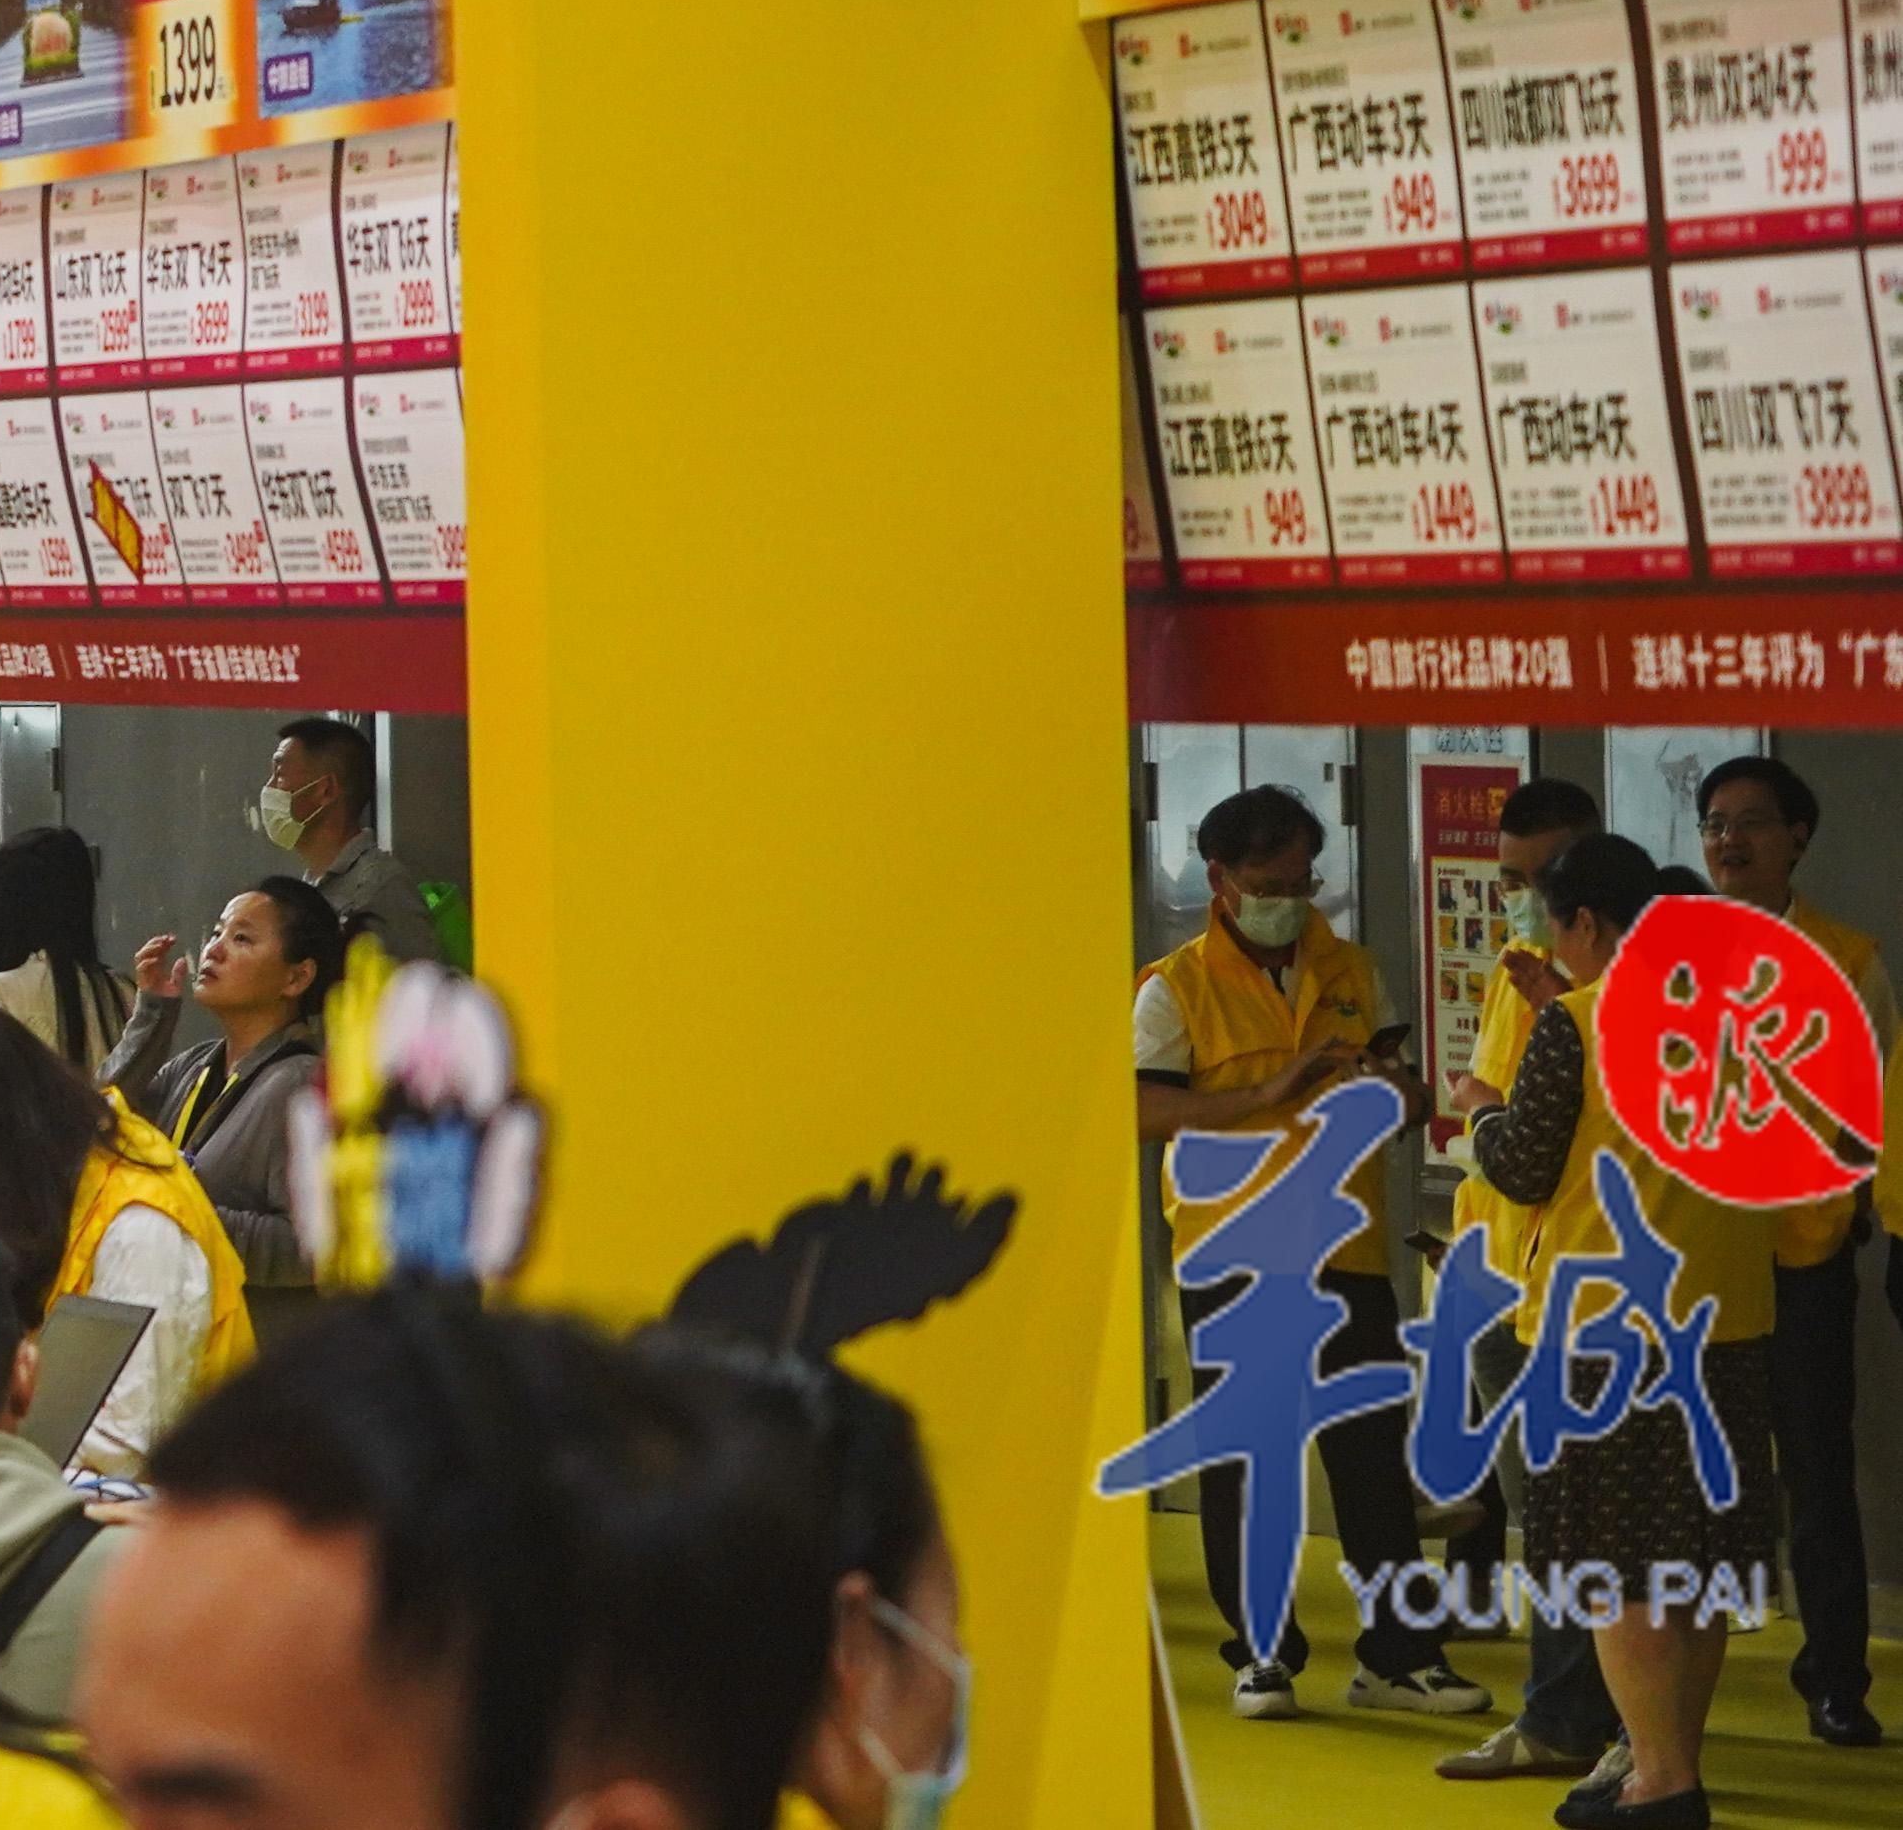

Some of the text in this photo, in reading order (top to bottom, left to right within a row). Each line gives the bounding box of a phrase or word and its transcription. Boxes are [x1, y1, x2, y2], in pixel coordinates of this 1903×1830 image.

[160, 15, 217, 107] 1399
[1778, 126, 1830, 197] 999
[1392, 171, 1439, 235] 949
[1264, 487, 1308, 548] 949
